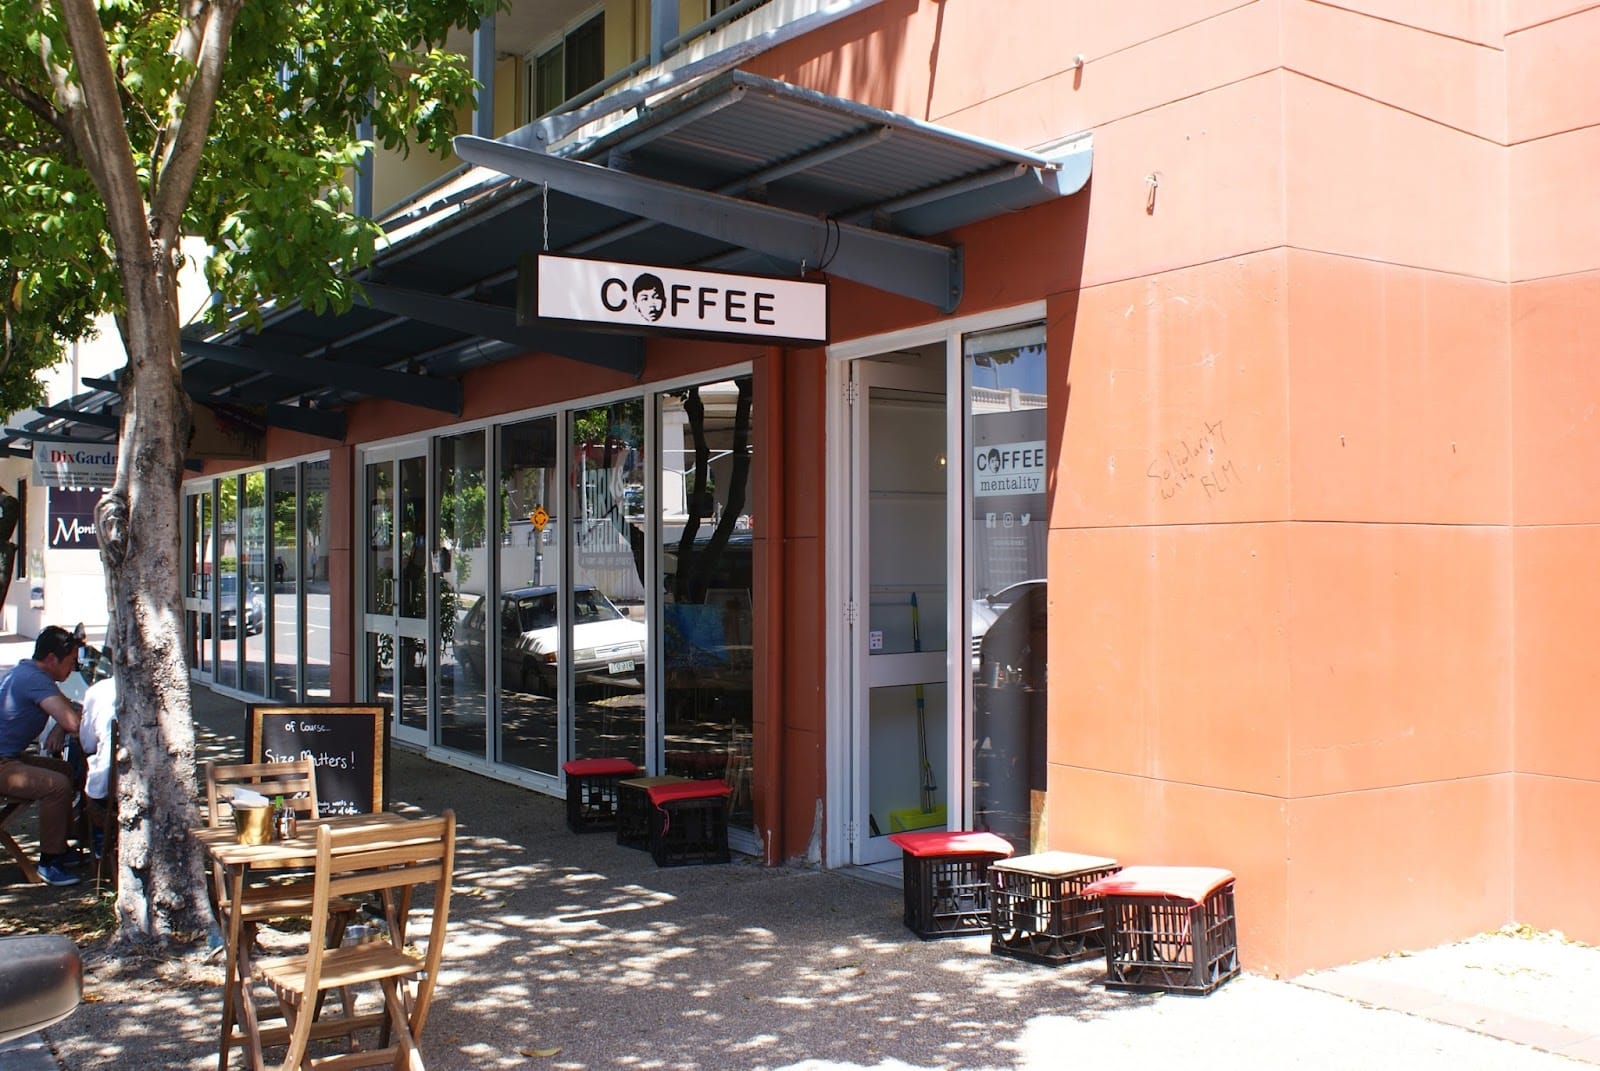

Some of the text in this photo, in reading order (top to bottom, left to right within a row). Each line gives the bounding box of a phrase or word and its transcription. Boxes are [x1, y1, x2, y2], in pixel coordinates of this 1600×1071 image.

[51, 450, 118, 465] DixGardn
[980, 476, 1040, 492] mentality
[53, 517, 97, 545] Mont
[284, 720, 296, 732] of
[265, 749, 295, 764] Size
